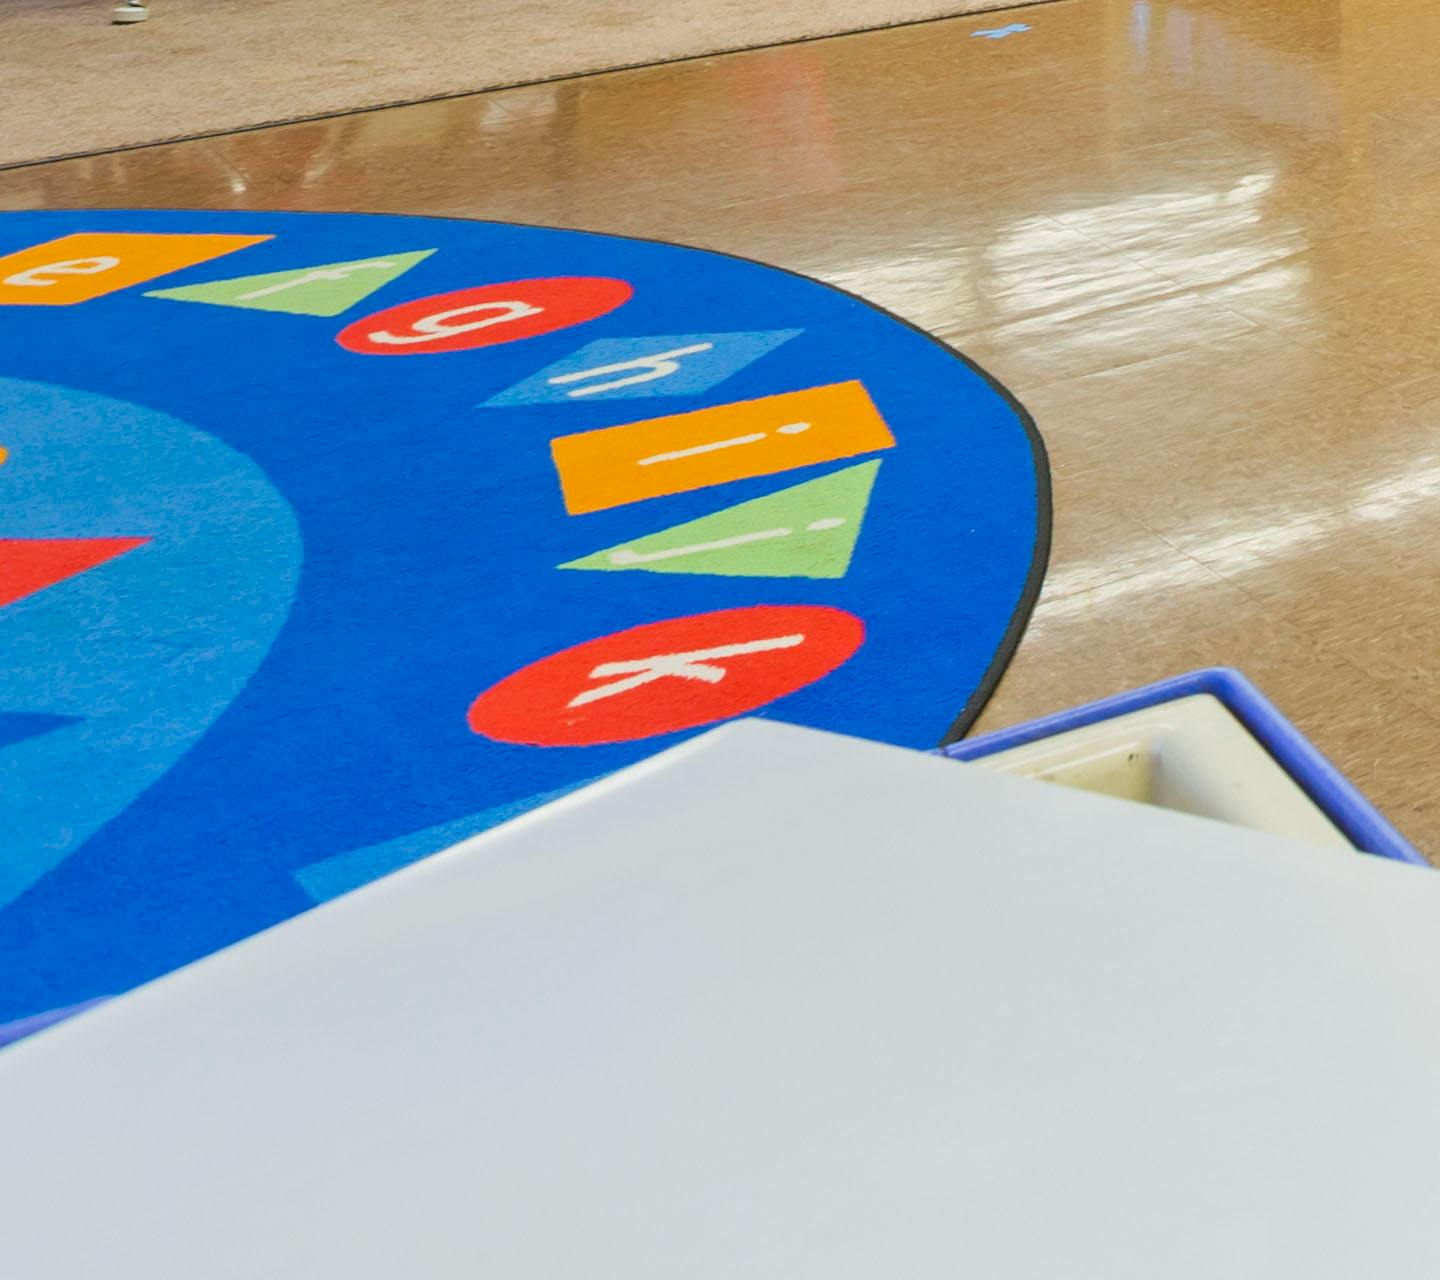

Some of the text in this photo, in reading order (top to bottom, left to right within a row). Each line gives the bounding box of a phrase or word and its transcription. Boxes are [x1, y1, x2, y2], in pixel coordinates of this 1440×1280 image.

[3, 256, 120, 287] e
[235, 260, 396, 301] f
[368, 300, 545, 345] g
[548, 343, 713, 398] h
[638, 422, 811, 467] i
[609, 517, 847, 566] j
